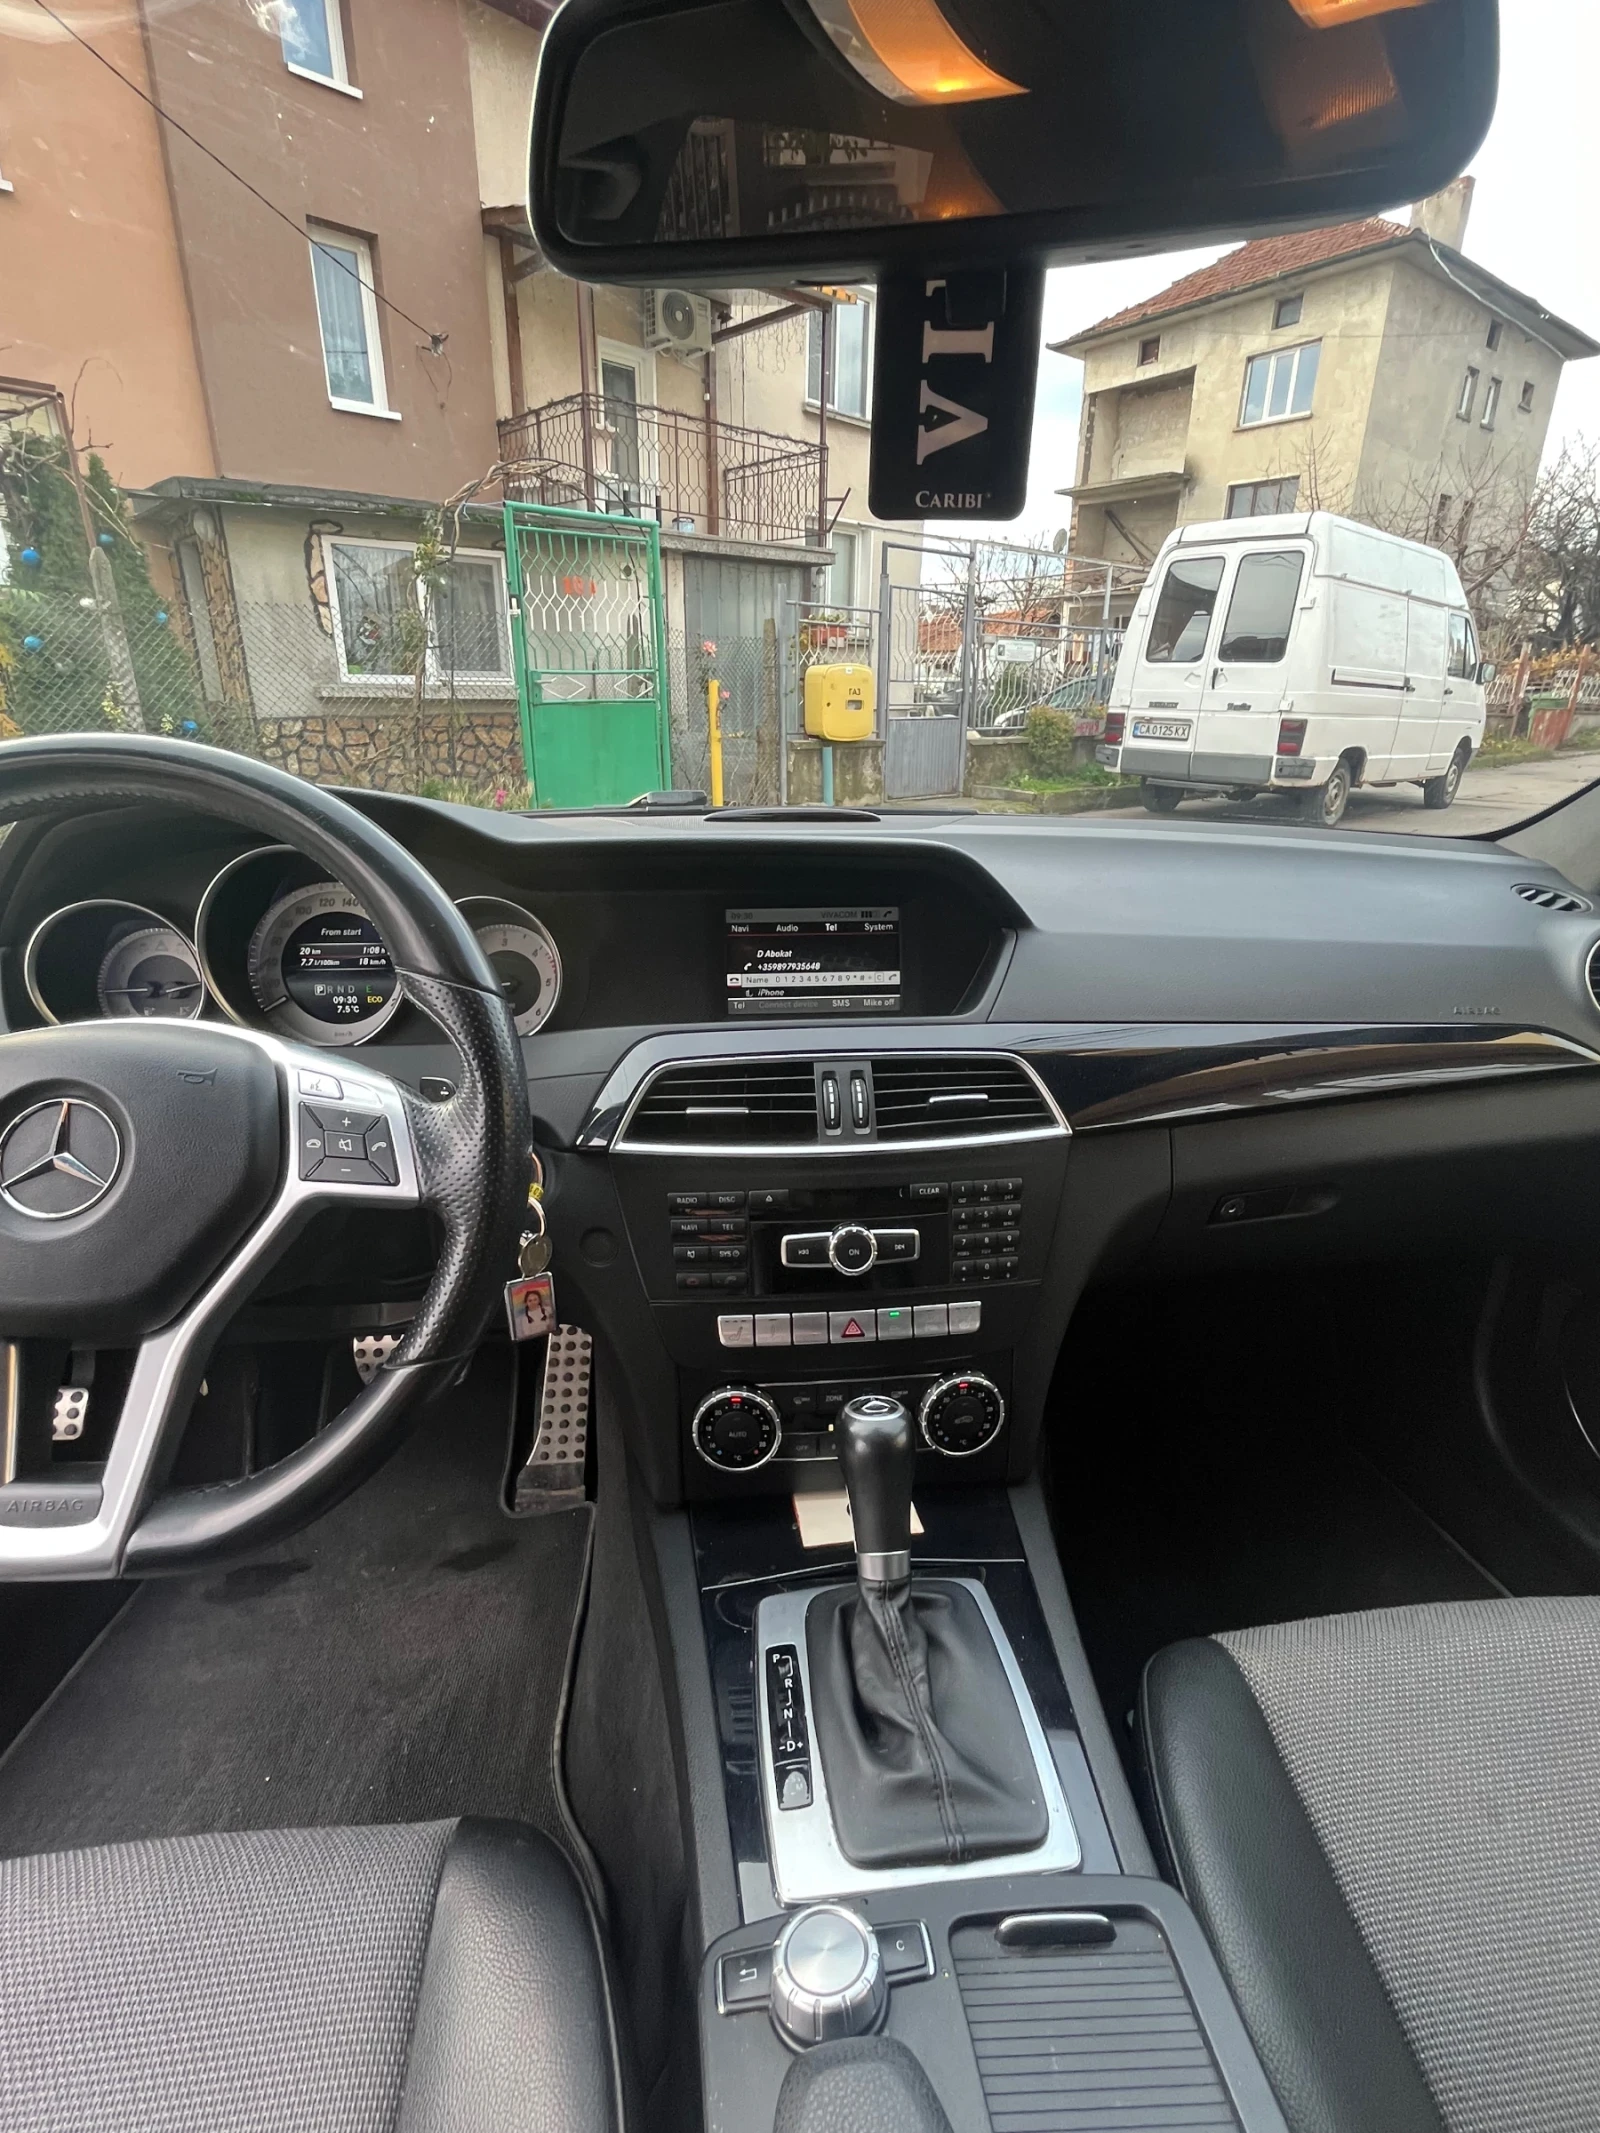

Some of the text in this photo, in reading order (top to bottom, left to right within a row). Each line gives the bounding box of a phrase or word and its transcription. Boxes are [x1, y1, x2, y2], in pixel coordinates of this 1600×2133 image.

[1151, 725, 1173, 737] 0125
[776, 924, 799, 932] Audio
[825, 923, 838, 931] Tel
[864, 923, 894, 932] System
[320, 928, 362, 936] From start
[300, 947, 310, 955] 20
[362, 946, 380, 954] 1:08
[757, 950, 793, 958] D Abokat
[300, 958, 314, 966] 7.7
[746, 976, 769, 984] Name
[348, 985, 355, 993] D
[757, 989, 785, 997] iPhone
[332, 996, 383, 1004] 09:30 ECO
[832, 999, 851, 1007] SMS
[863, 998, 895, 1006] Mike off
[733, 1002, 745, 1010] Tel
[919, 1187, 940, 1195] CLEAR
[718, 1196, 736, 1204] DISC
[825, 1394, 843, 1402] ZONE
[728, 1430, 747, 1438] AUTO
[6, 1499, 83, 1512] AIRBAG
[773, 1654, 780, 1663] P
[785, 1678, 793, 1688] R
[783, 1708, 793, 1719] N
[896, 1940, 905, 1951] C
